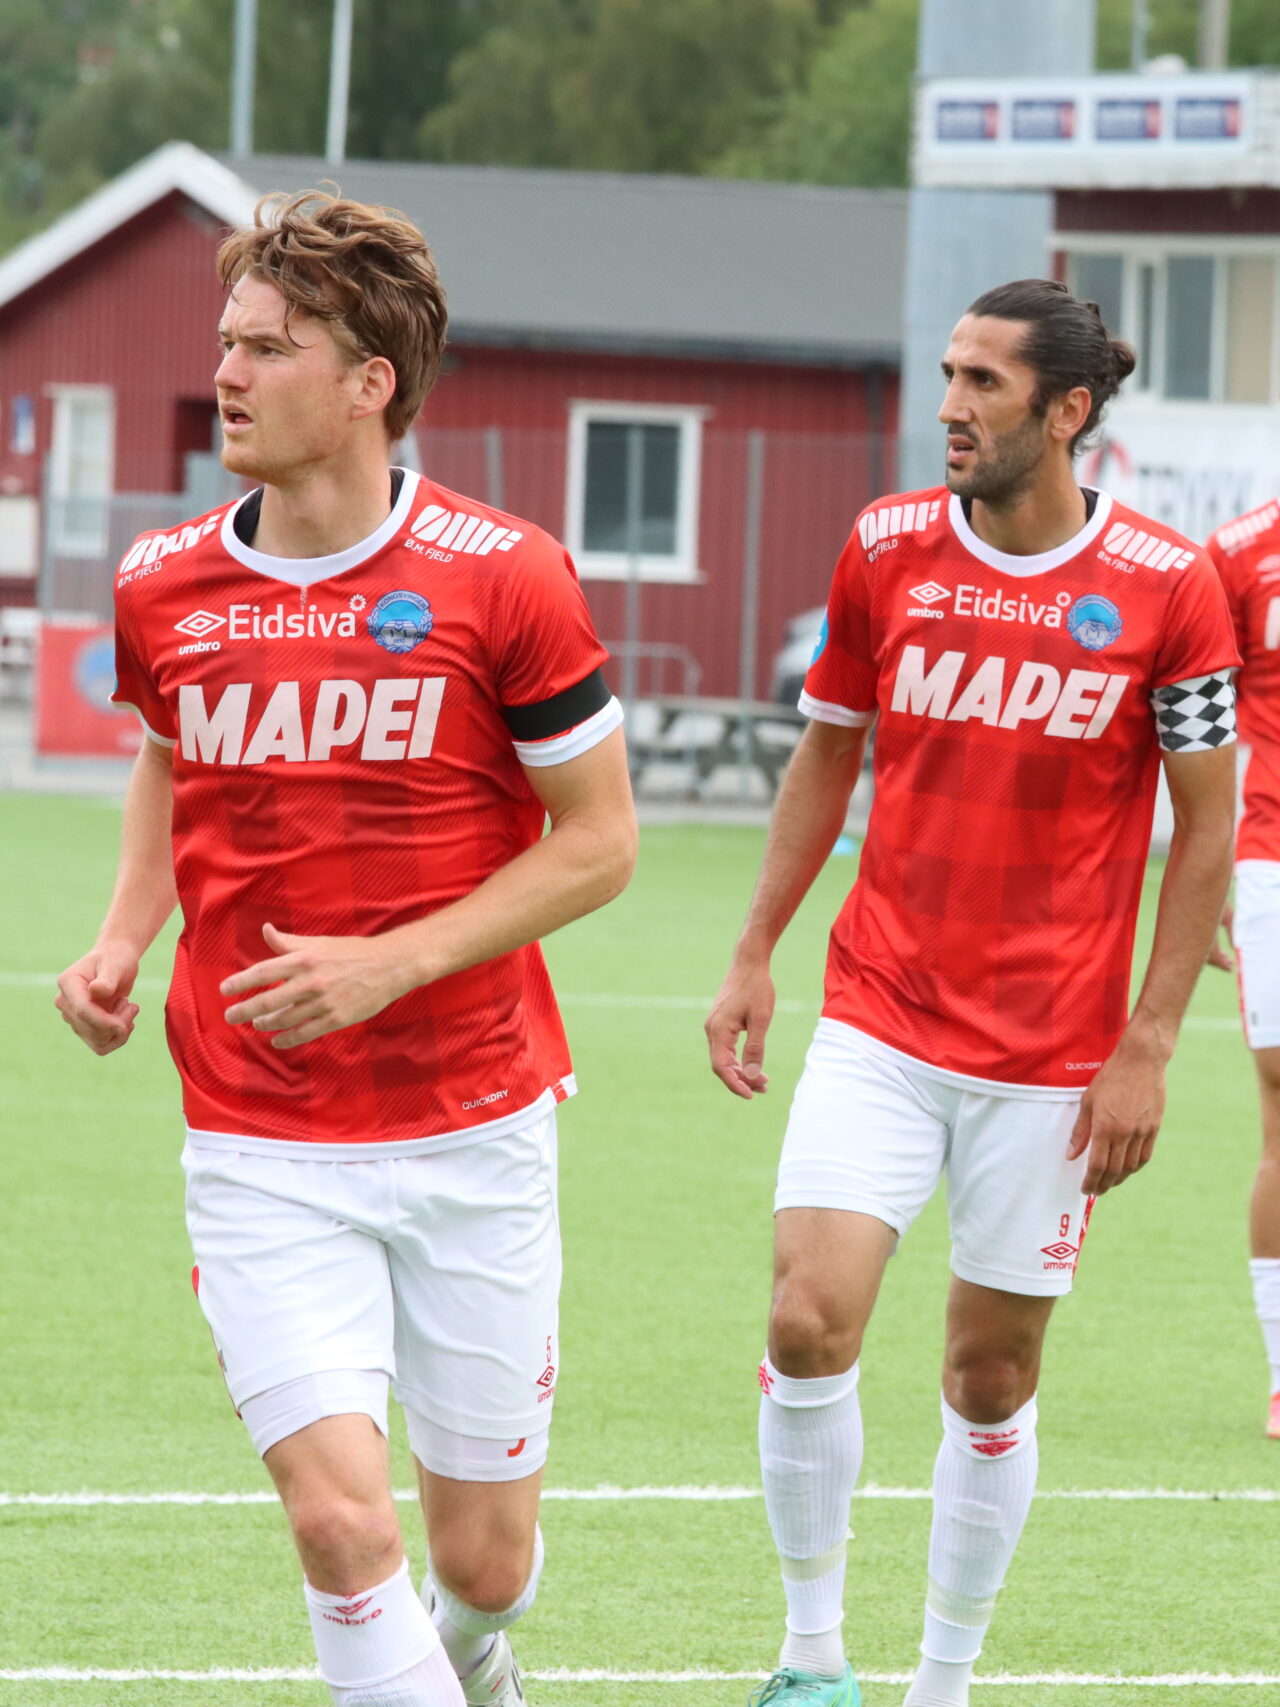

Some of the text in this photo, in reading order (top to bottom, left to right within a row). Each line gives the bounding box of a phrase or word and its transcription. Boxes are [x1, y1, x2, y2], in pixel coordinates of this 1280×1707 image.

[425, 548, 454, 563] FJELD
[134, 561, 163, 579] FJELD
[1112, 558, 1136, 574] FJELD
[907, 607, 945, 620] umbro
[954, 584, 1062, 628] Eidsiva
[229, 603, 357, 640] Eidsiva
[178, 641, 221, 655] umbro
[891, 645, 1129, 739] MAPEI
[179, 676, 447, 766] MAPEI
[462, 1089, 509, 1110] QUICKDRY
[1059, 1213, 1070, 1237] 9
[1043, 1260, 1074, 1270] umbro
[323, 1607, 382, 1626] umbro
